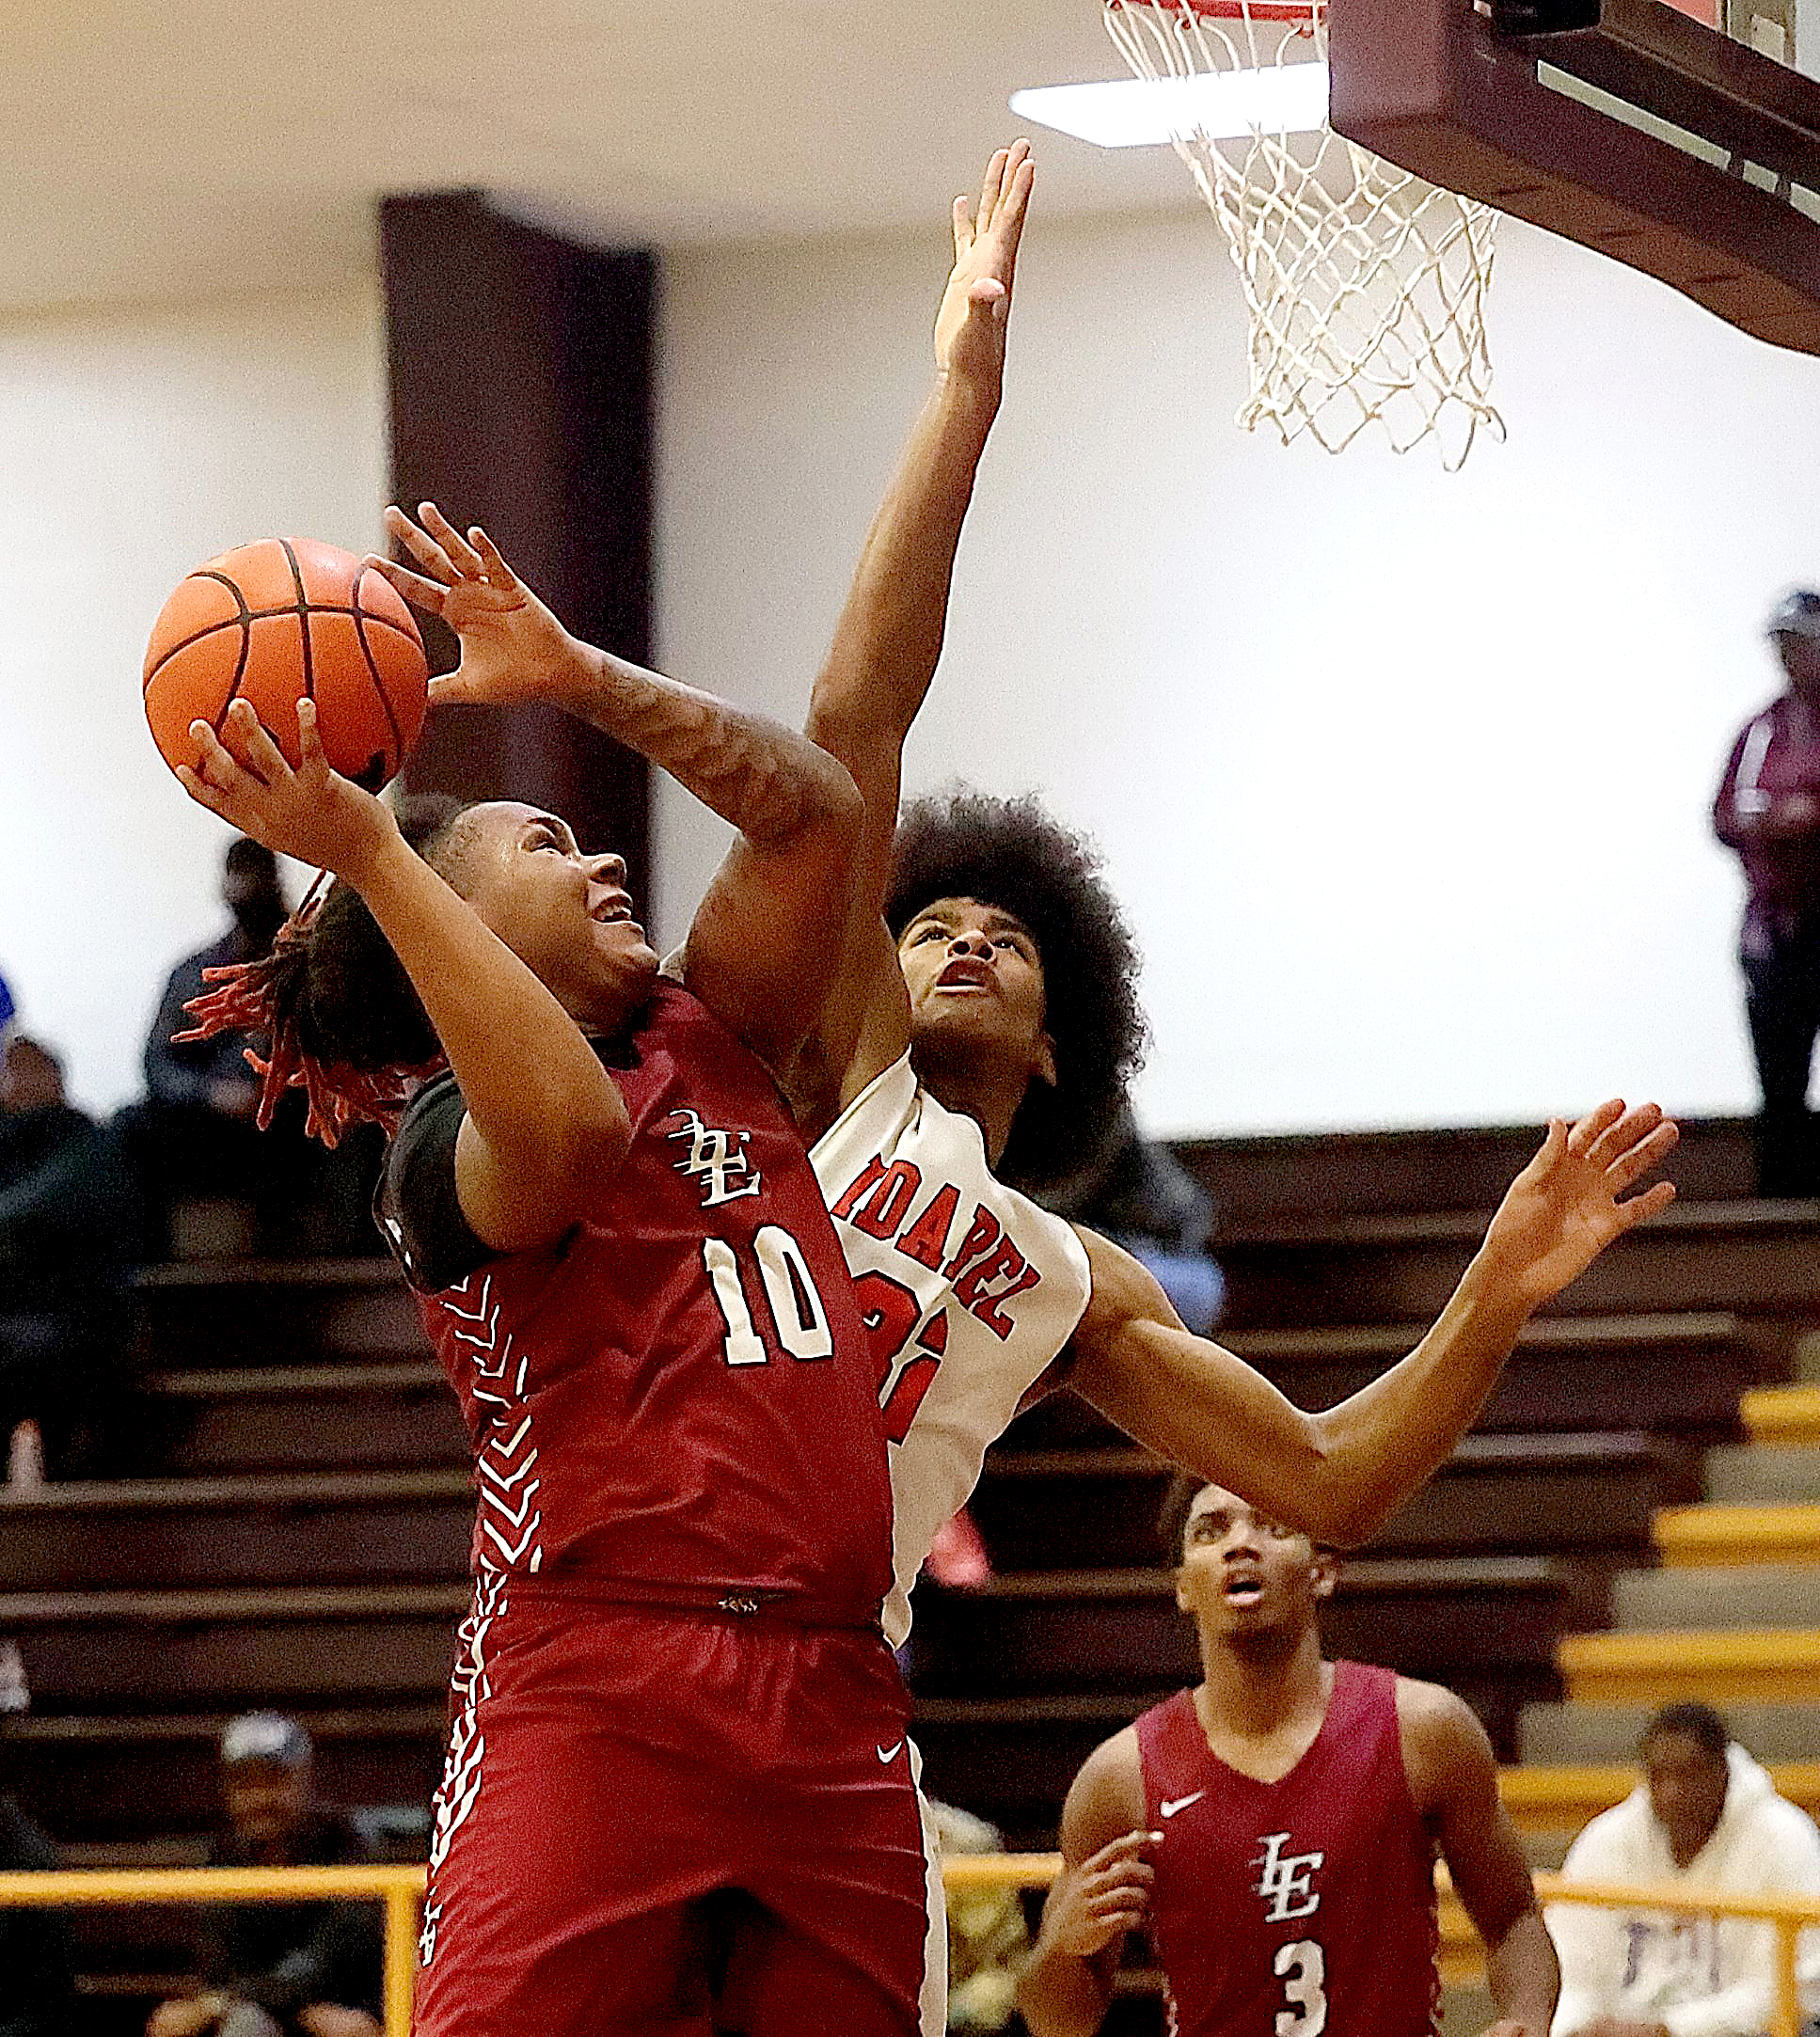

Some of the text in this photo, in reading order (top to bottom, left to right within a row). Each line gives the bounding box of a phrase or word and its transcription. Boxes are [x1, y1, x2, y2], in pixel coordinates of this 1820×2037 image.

[703, 1224, 833, 1365] 10
[1249, 1832, 1324, 1923] LE
[1274, 1938, 1327, 2037] 3
